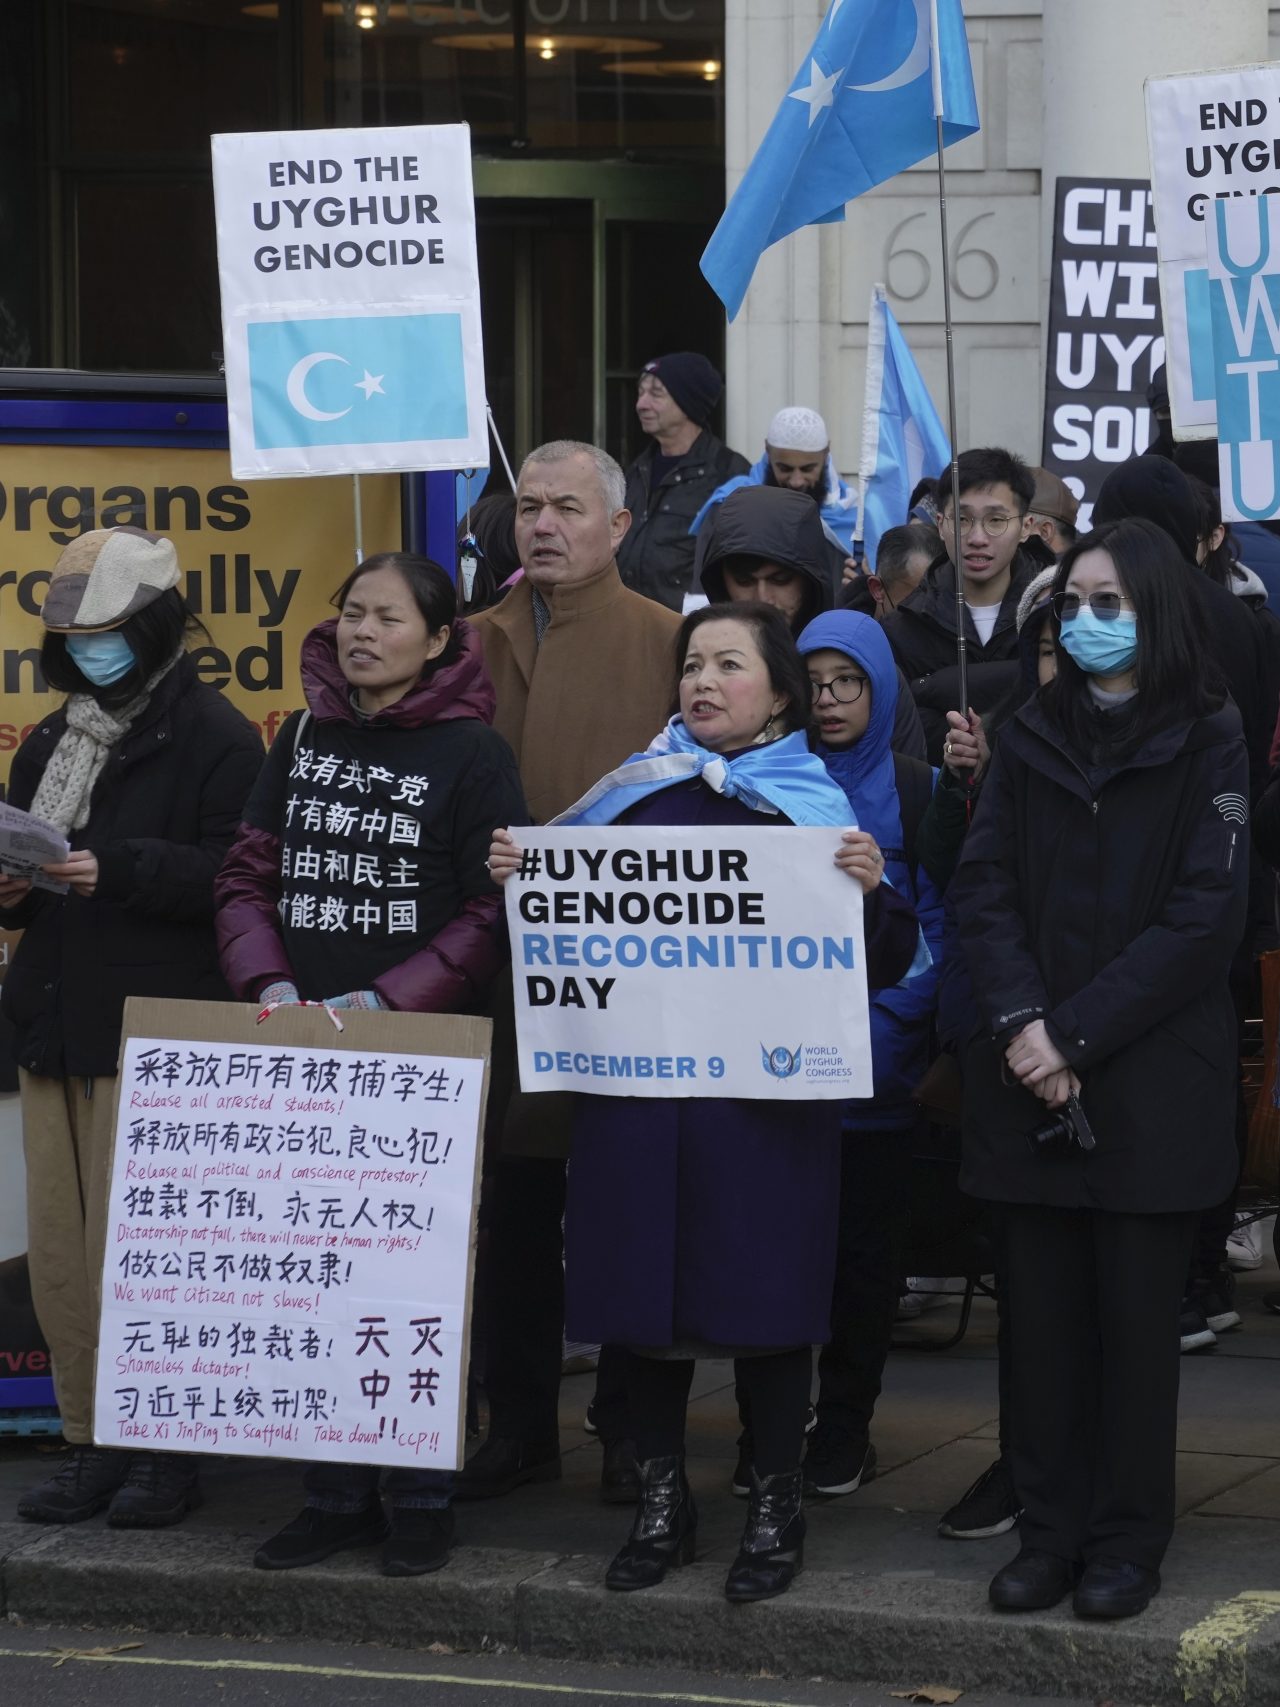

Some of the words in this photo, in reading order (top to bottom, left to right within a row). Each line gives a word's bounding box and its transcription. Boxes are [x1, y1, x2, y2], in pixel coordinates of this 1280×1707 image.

[1200, 98, 1268, 131] END
[268, 159, 343, 187] END
[354, 156, 419, 183] THE
[253, 194, 441, 231] UYGHUR
[253, 238, 445, 273] GENOCIDE
[883, 211, 999, 301] 66
[0, 480, 251, 546] rgans
[518, 848, 749, 882] #UYGHUR
[518, 890, 766, 925] GENOCIDE
[522, 933, 855, 970] RECOGNITION
[526, 975, 616, 1010] DAY
[533, 1051, 697, 1079] DECEMBER
[707, 1056, 726, 1079] 9
[805, 1046, 838, 1056] WORLD
[805, 1057, 844, 1067] UYGHUR
[805, 1067, 853, 1078] CONGRESS
[130, 1090, 182, 1109] Release
[190, 1093, 208, 1109] all
[216, 1094, 274, 1111] arrested
[125, 1160, 181, 1180] Release
[181, 1164, 198, 1180] all
[202, 1161, 249, 1186] political
[256, 1162, 283, 1181] and
[291, 1165, 356, 1181] conscience
[116, 1223, 189, 1247] Dictatorship
[191, 1227, 209, 1241] not
[240, 1227, 267, 1243] there
[269, 1231, 291, 1246] will
[292, 1232, 324, 1246] never
[324, 1232, 338, 1247] be
[340, 1231, 372, 1248] human
[113, 1282, 135, 1302] We
[141, 1285, 179, 1304] want
[242, 1289, 265, 1308] not
[115, 1354, 184, 1376] Shameless
[117, 1420, 151, 1439] Take
[154, 1422, 169, 1439] Xi
[225, 1423, 238, 1437] to
[314, 1424, 344, 1443] Take
